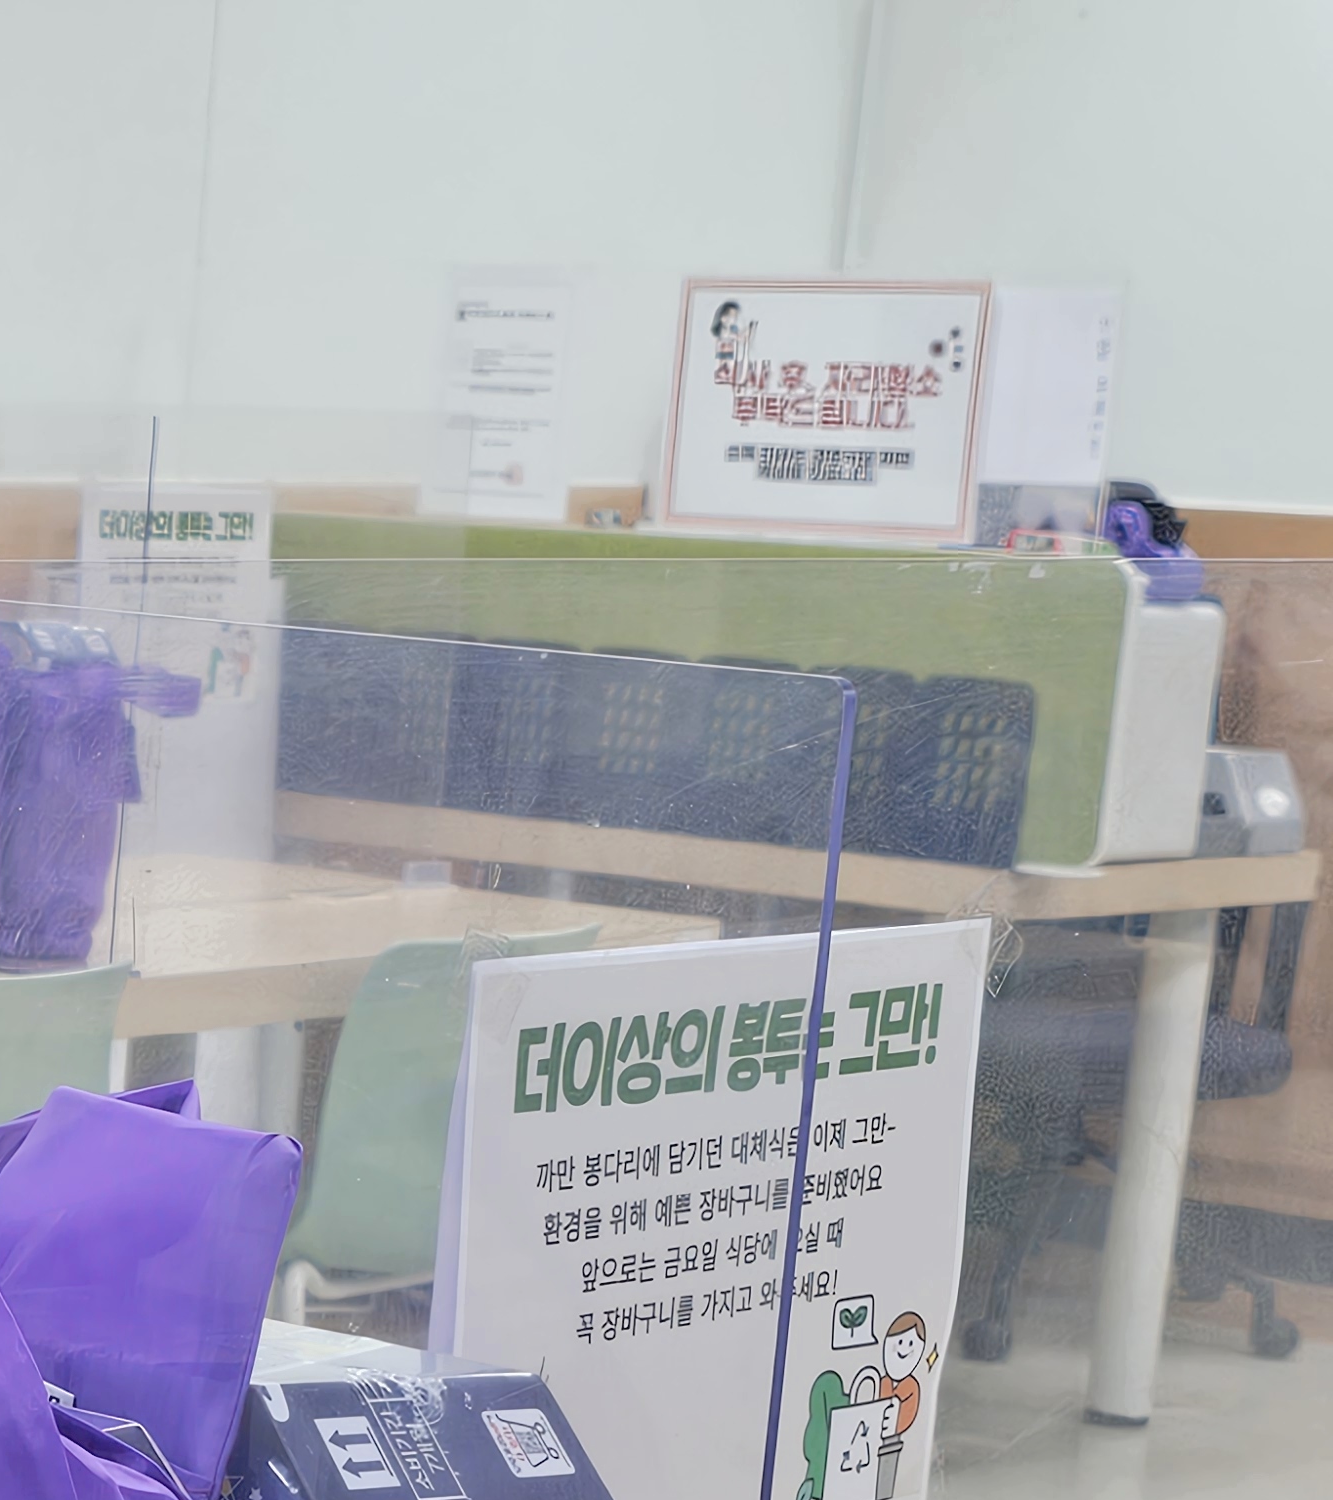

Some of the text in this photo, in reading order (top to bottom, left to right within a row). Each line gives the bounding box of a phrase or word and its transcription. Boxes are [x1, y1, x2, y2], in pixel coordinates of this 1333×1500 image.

[515, 1007, 725, 1112] 더이상의
[840, 984, 943, 1074] 그만!
[536, 1155, 576, 1194] 까만
[582, 1143, 661, 1188] 봉다리에
[668, 1134, 723, 1175] 담기던
[813, 1117, 847, 1153] 이제
[542, 1206, 603, 1247] 환경을
[609, 1197, 648, 1236] 위해
[654, 1192, 692, 1228] 예쁜
[698, 1177, 789, 1222] 장바구니를
[581, 1251, 657, 1294] 앞으로는
[663, 1238, 719, 1280] 금요일
[725, 1228, 778, 1268] 식당에
[826, 1216, 845, 1249] 때
[575, 1312, 595, 1345] 꼭
[600, 1294, 694, 1342] 장바구니를
[700, 1285, 753, 1322] 가지고
